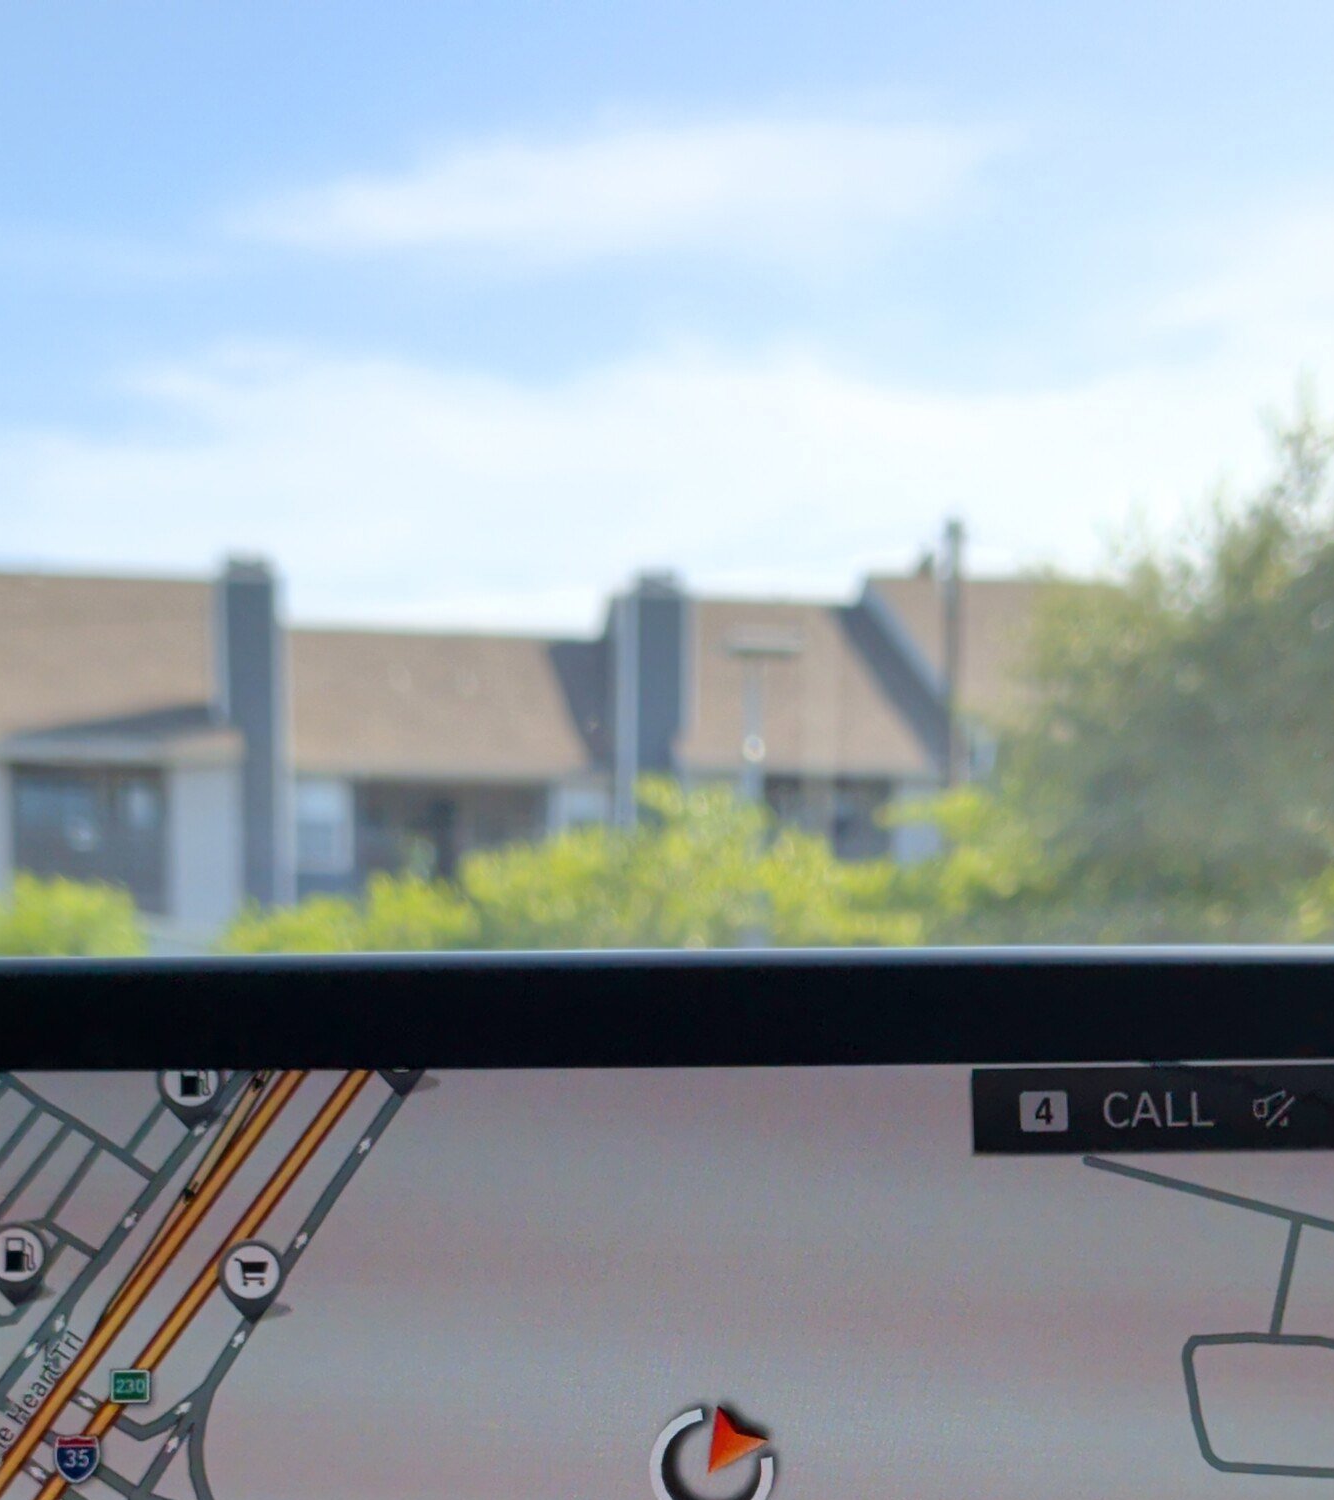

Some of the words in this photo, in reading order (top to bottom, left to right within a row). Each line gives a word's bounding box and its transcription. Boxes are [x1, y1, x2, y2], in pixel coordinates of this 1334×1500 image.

[1034, 1096, 1055, 1126] 4
[1103, 1090, 1215, 1129] CALL
[6, 1360, 63, 1426] Heart
[116, 1377, 146, 1394] 230
[64, 1450, 90, 1468] 35
